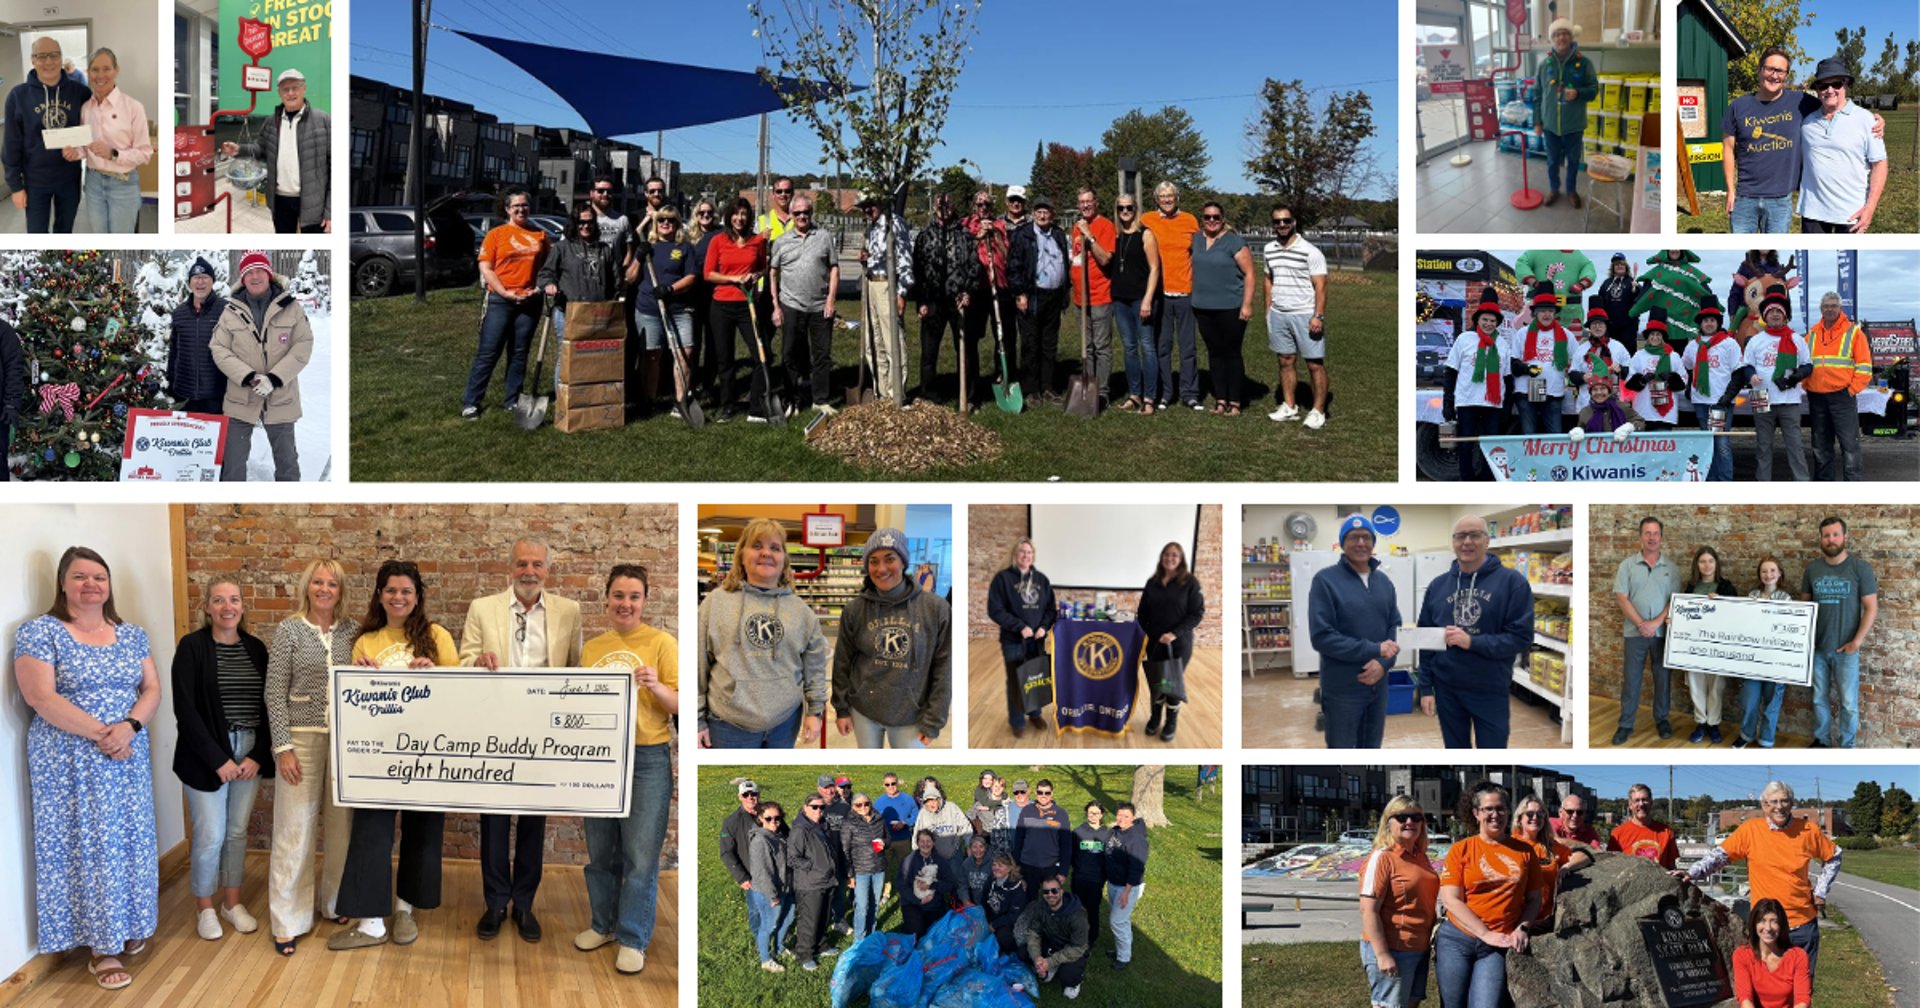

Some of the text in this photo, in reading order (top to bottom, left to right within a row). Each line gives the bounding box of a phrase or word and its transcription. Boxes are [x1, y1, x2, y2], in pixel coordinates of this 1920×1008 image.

[264, 0, 306, 14] FRE
[1744, 110, 1793, 127] Kiwanis
[1746, 139, 1793, 152] Auction
[1416, 258, 1452, 270] Station
[1523, 436, 1677, 461] Merry Christmas
[1572, 464, 1647, 481] Kiwanis
[342, 684, 431, 706] Kiwanis Club
[396, 732, 611, 761] Day Camp Buddy Program
[387, 758, 515, 784] eight hundred
